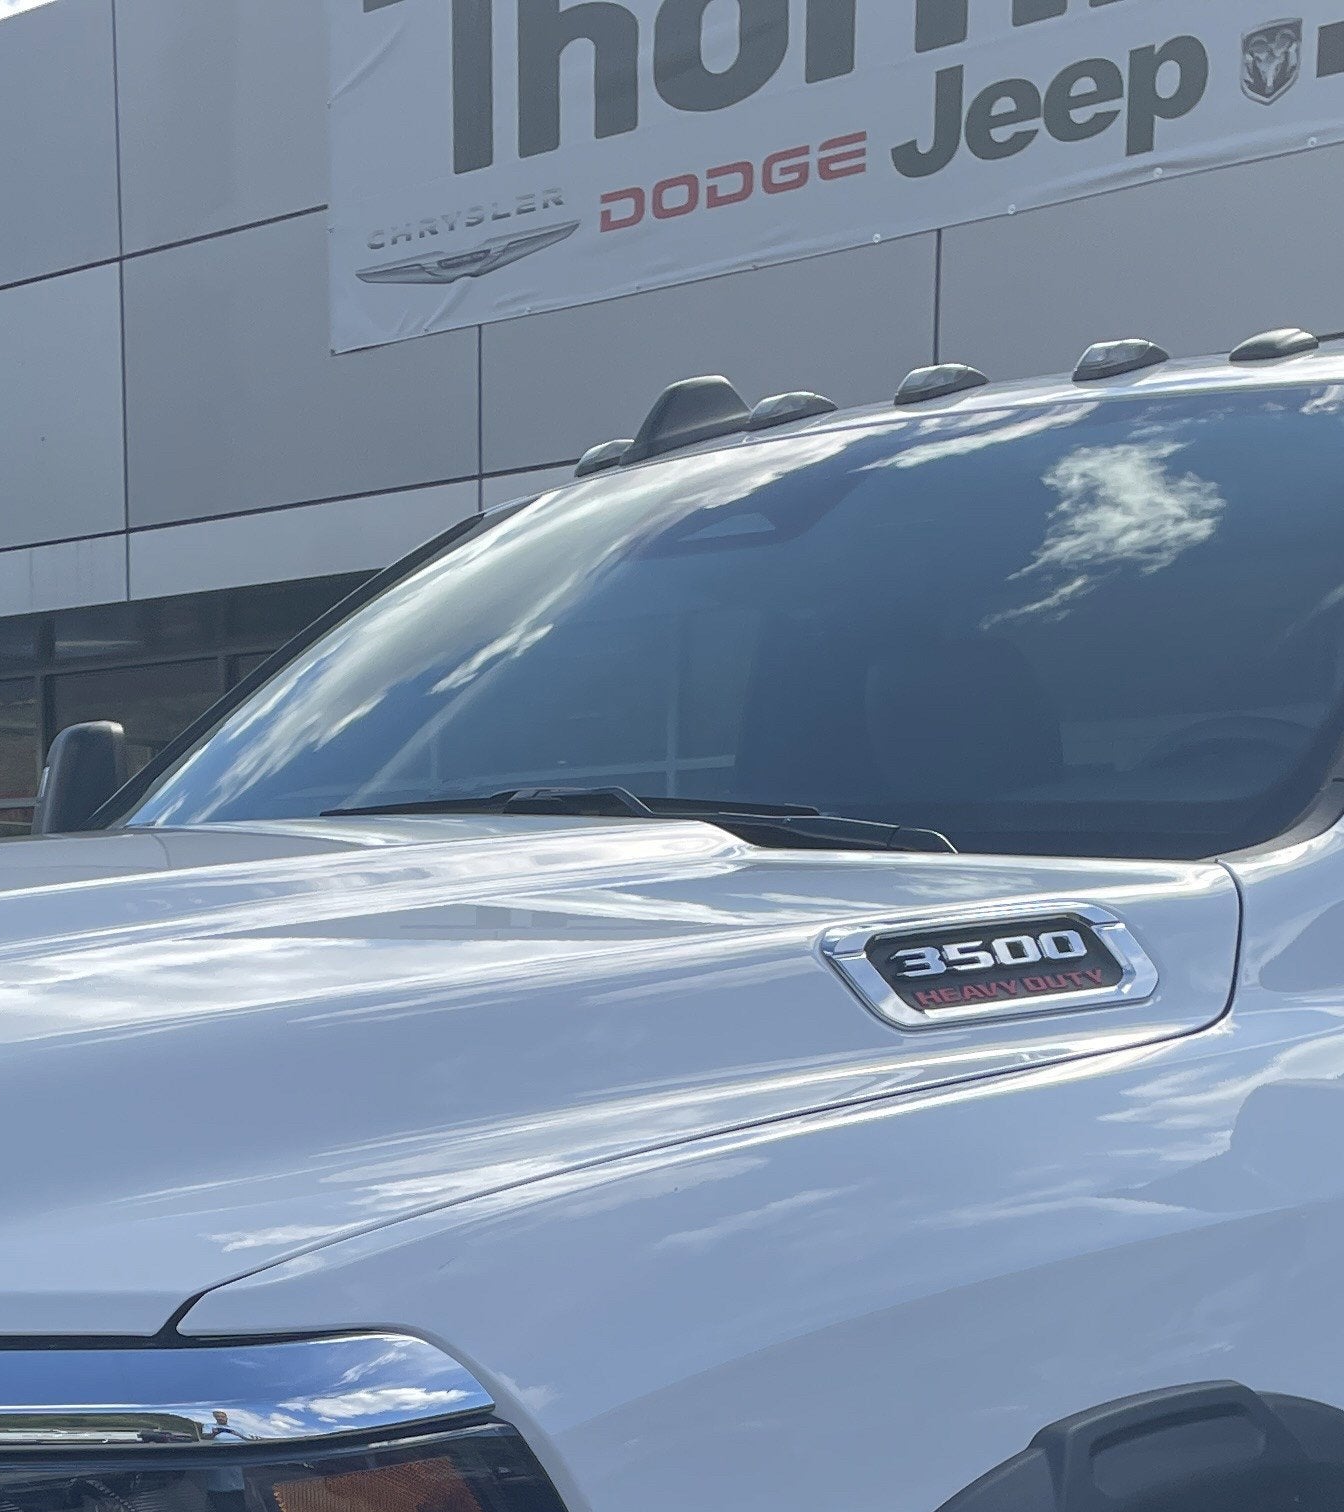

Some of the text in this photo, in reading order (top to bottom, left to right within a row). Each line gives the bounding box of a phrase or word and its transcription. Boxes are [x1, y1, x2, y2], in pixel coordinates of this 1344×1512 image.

[890, 35, 1210, 178] Jeep
[599, 131, 868, 234] DODGE
[366, 187, 565, 251] CHRYSLER
[890, 929, 1088, 978] 3500
[913, 967, 1103, 1008] HEAVY DUTY
